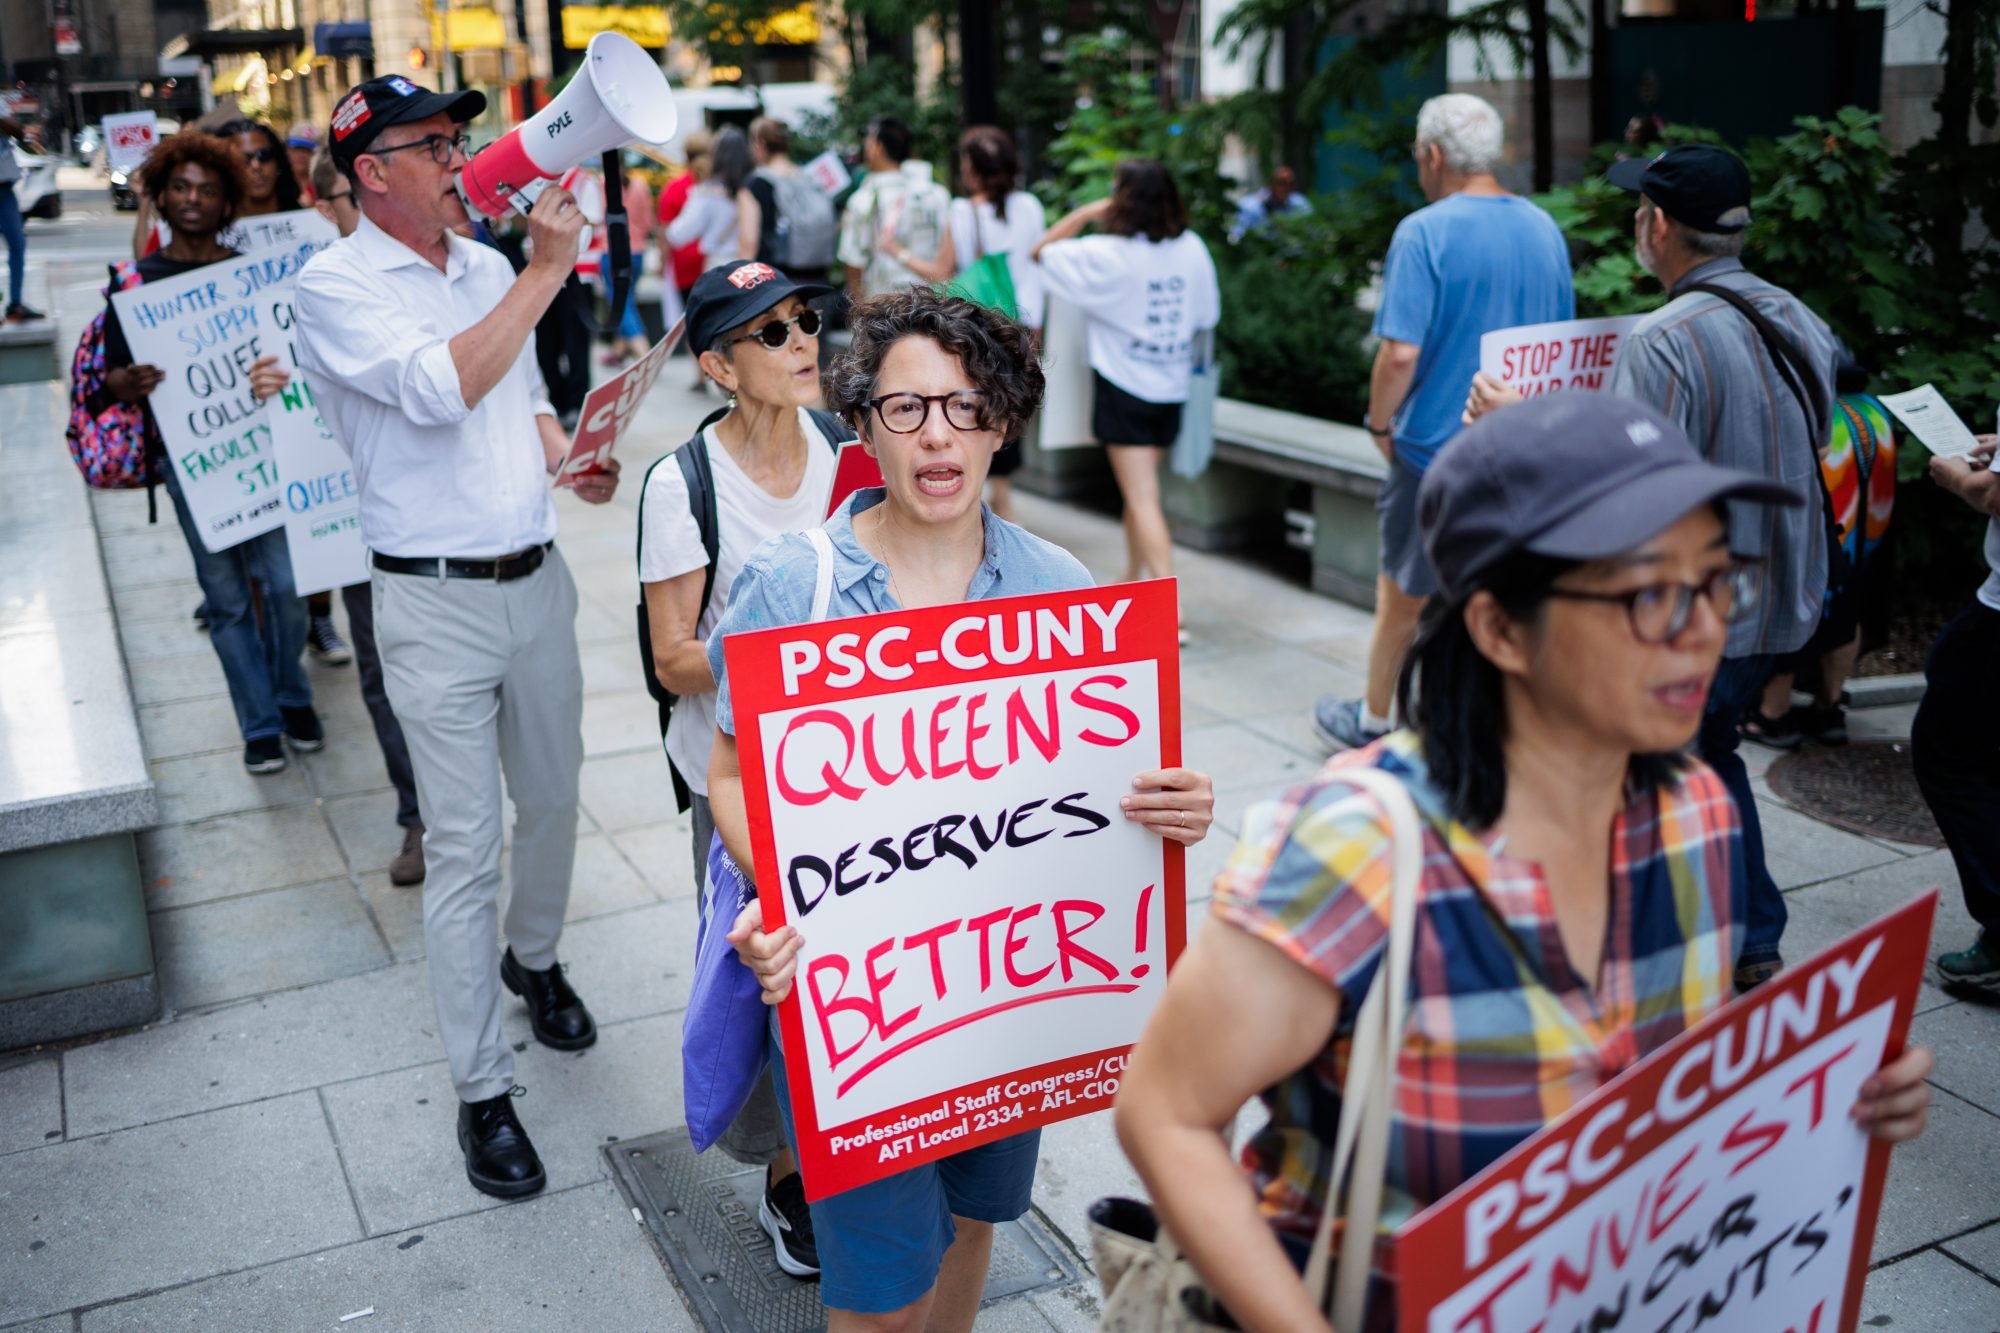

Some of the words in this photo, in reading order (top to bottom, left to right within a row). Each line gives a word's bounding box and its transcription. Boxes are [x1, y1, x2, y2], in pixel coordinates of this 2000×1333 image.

[547, 110, 573, 138] PYLE
[133, 280, 227, 329] HUNTER
[728, 262, 777, 288] PSC
[1502, 341, 1562, 381] STOP
[1570, 333, 1618, 370] THE
[181, 422, 273, 482] FACULTY
[287, 469, 360, 515] QUEE
[310, 516, 359, 539] HUNTE
[780, 598, 1133, 697] PSC-CUNY
[775, 674, 1141, 807] QUEENS
[787, 791, 1111, 918] DESERVES
[806, 883, 1156, 1074] BETTER!
[830, 1100, 950, 1155] Professional
[954, 1084, 1001, 1115] Staff
[1004, 1053, 1134, 1099] Congress/CU
[878, 1135, 915, 1163] AFT
[918, 1117, 969, 1149] Local
[973, 1101, 1024, 1132] 2334
[1040, 1077, 1120, 1112] AFL-CIO
[1464, 935, 1885, 1270] PSC-CUNY
[709, 1183, 787, 1290] ELECTRICAL
[1641, 1194, 1758, 1304] OUR
